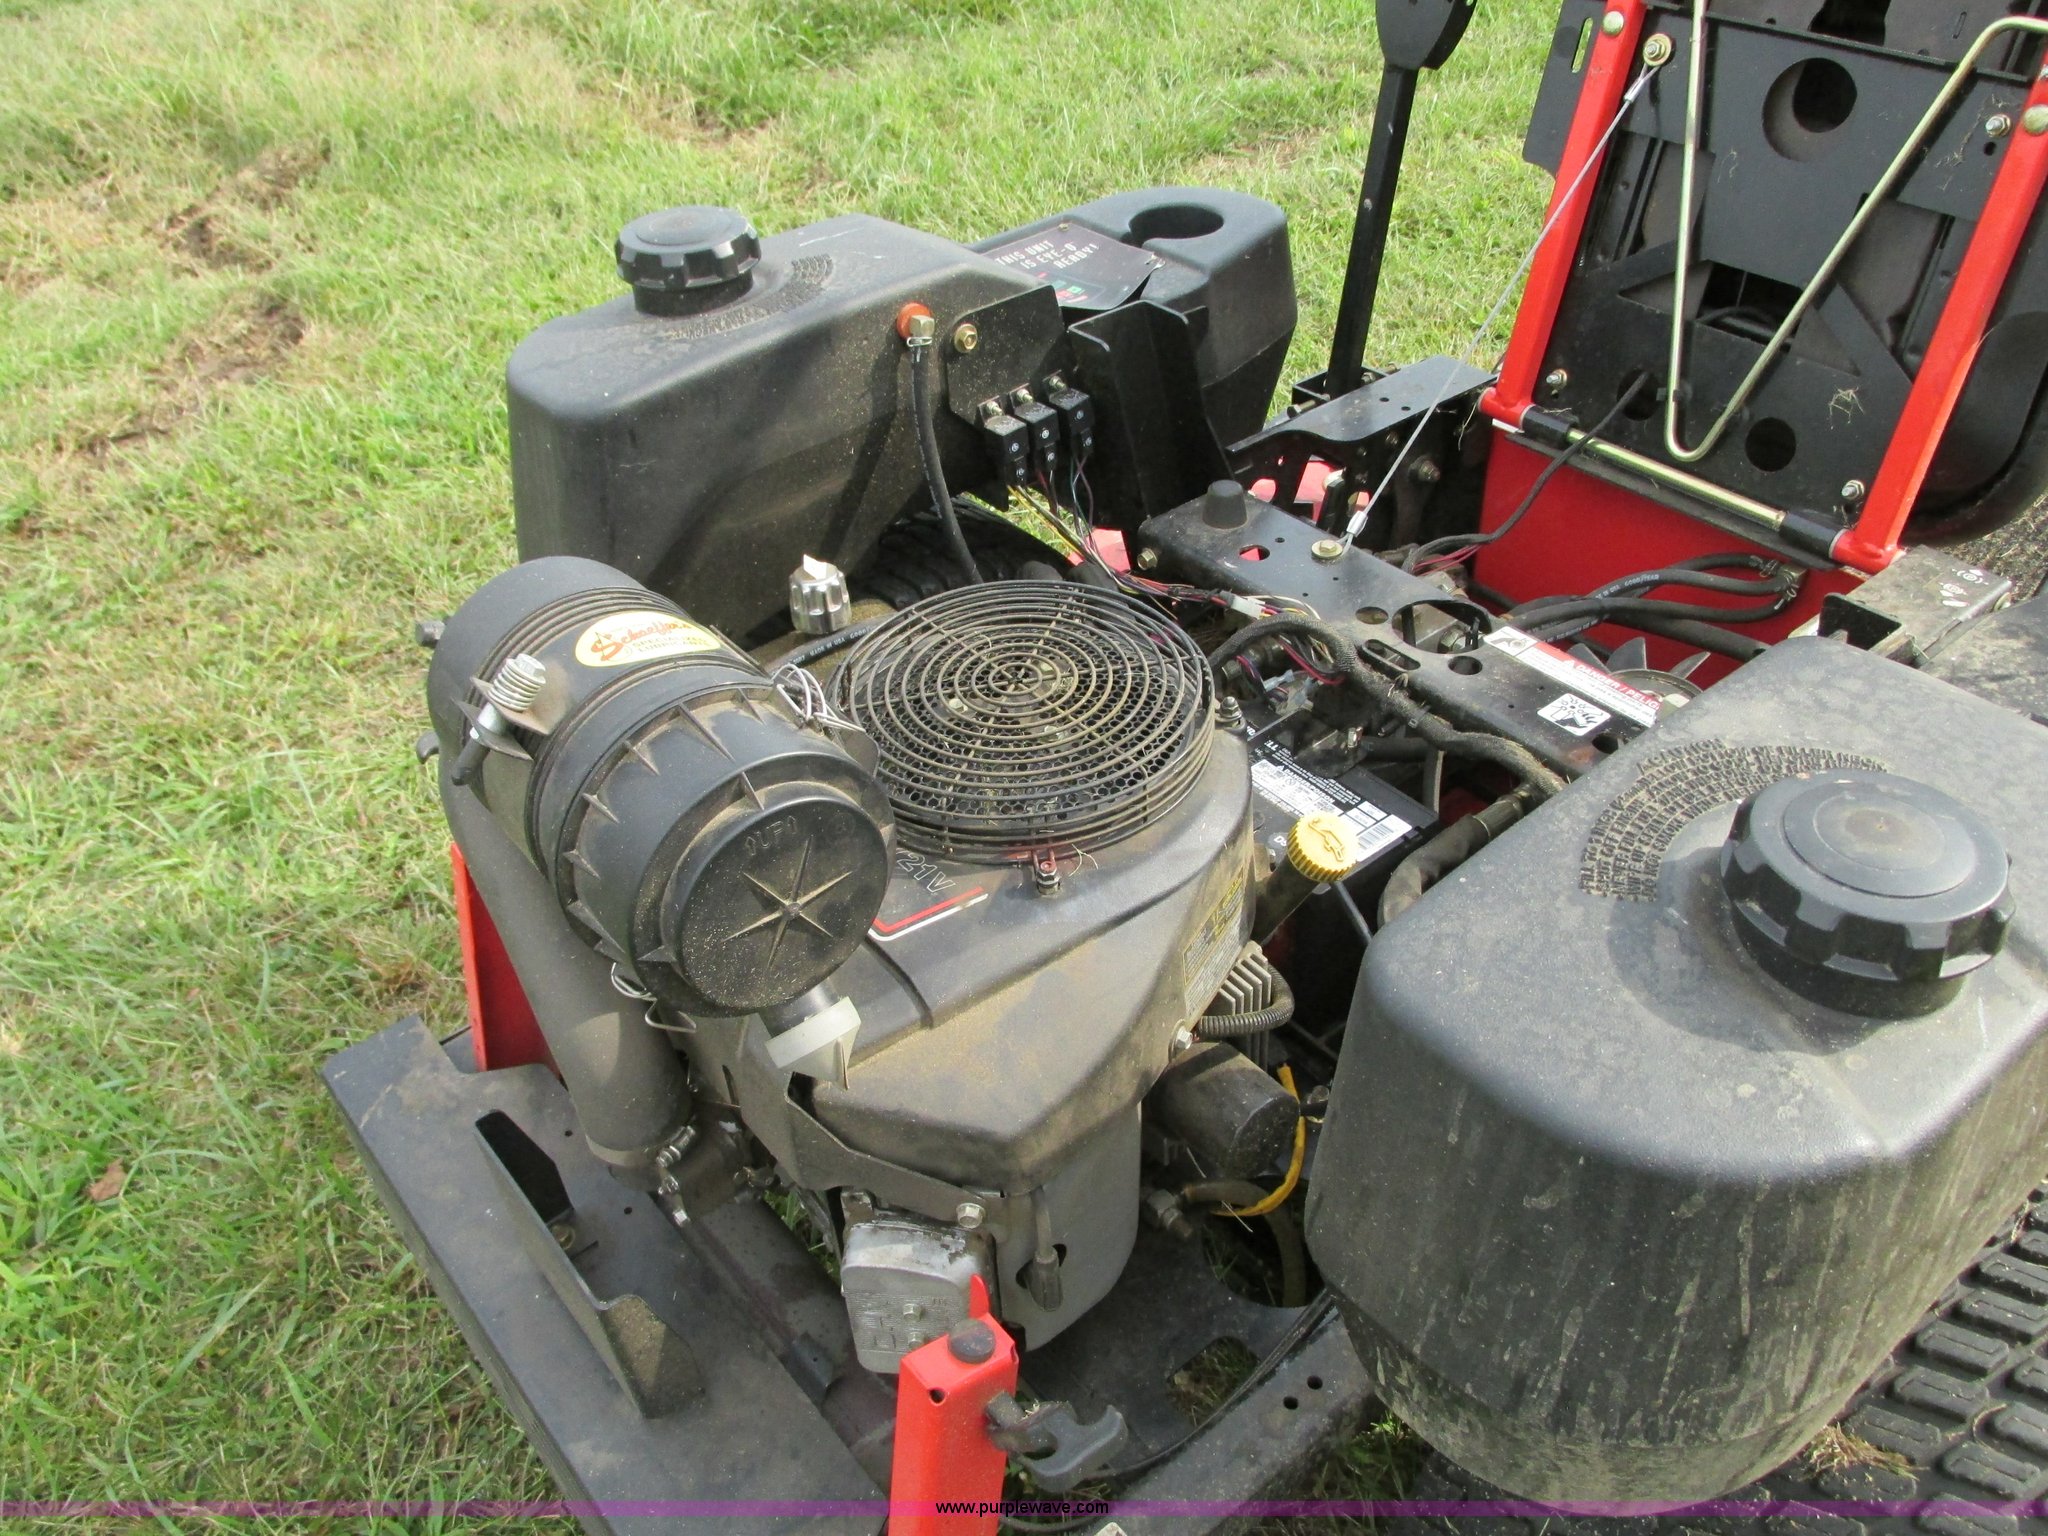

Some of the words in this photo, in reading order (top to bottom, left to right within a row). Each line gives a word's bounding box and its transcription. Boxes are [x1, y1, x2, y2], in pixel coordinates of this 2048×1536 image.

[995, 252, 1025, 266] THIS
[1025, 240, 1054, 255] UNIT
[1020, 259, 1037, 269] IS
[1577, 663, 1621, 690] DANGER
[1626, 688, 1660, 711] PELIG
